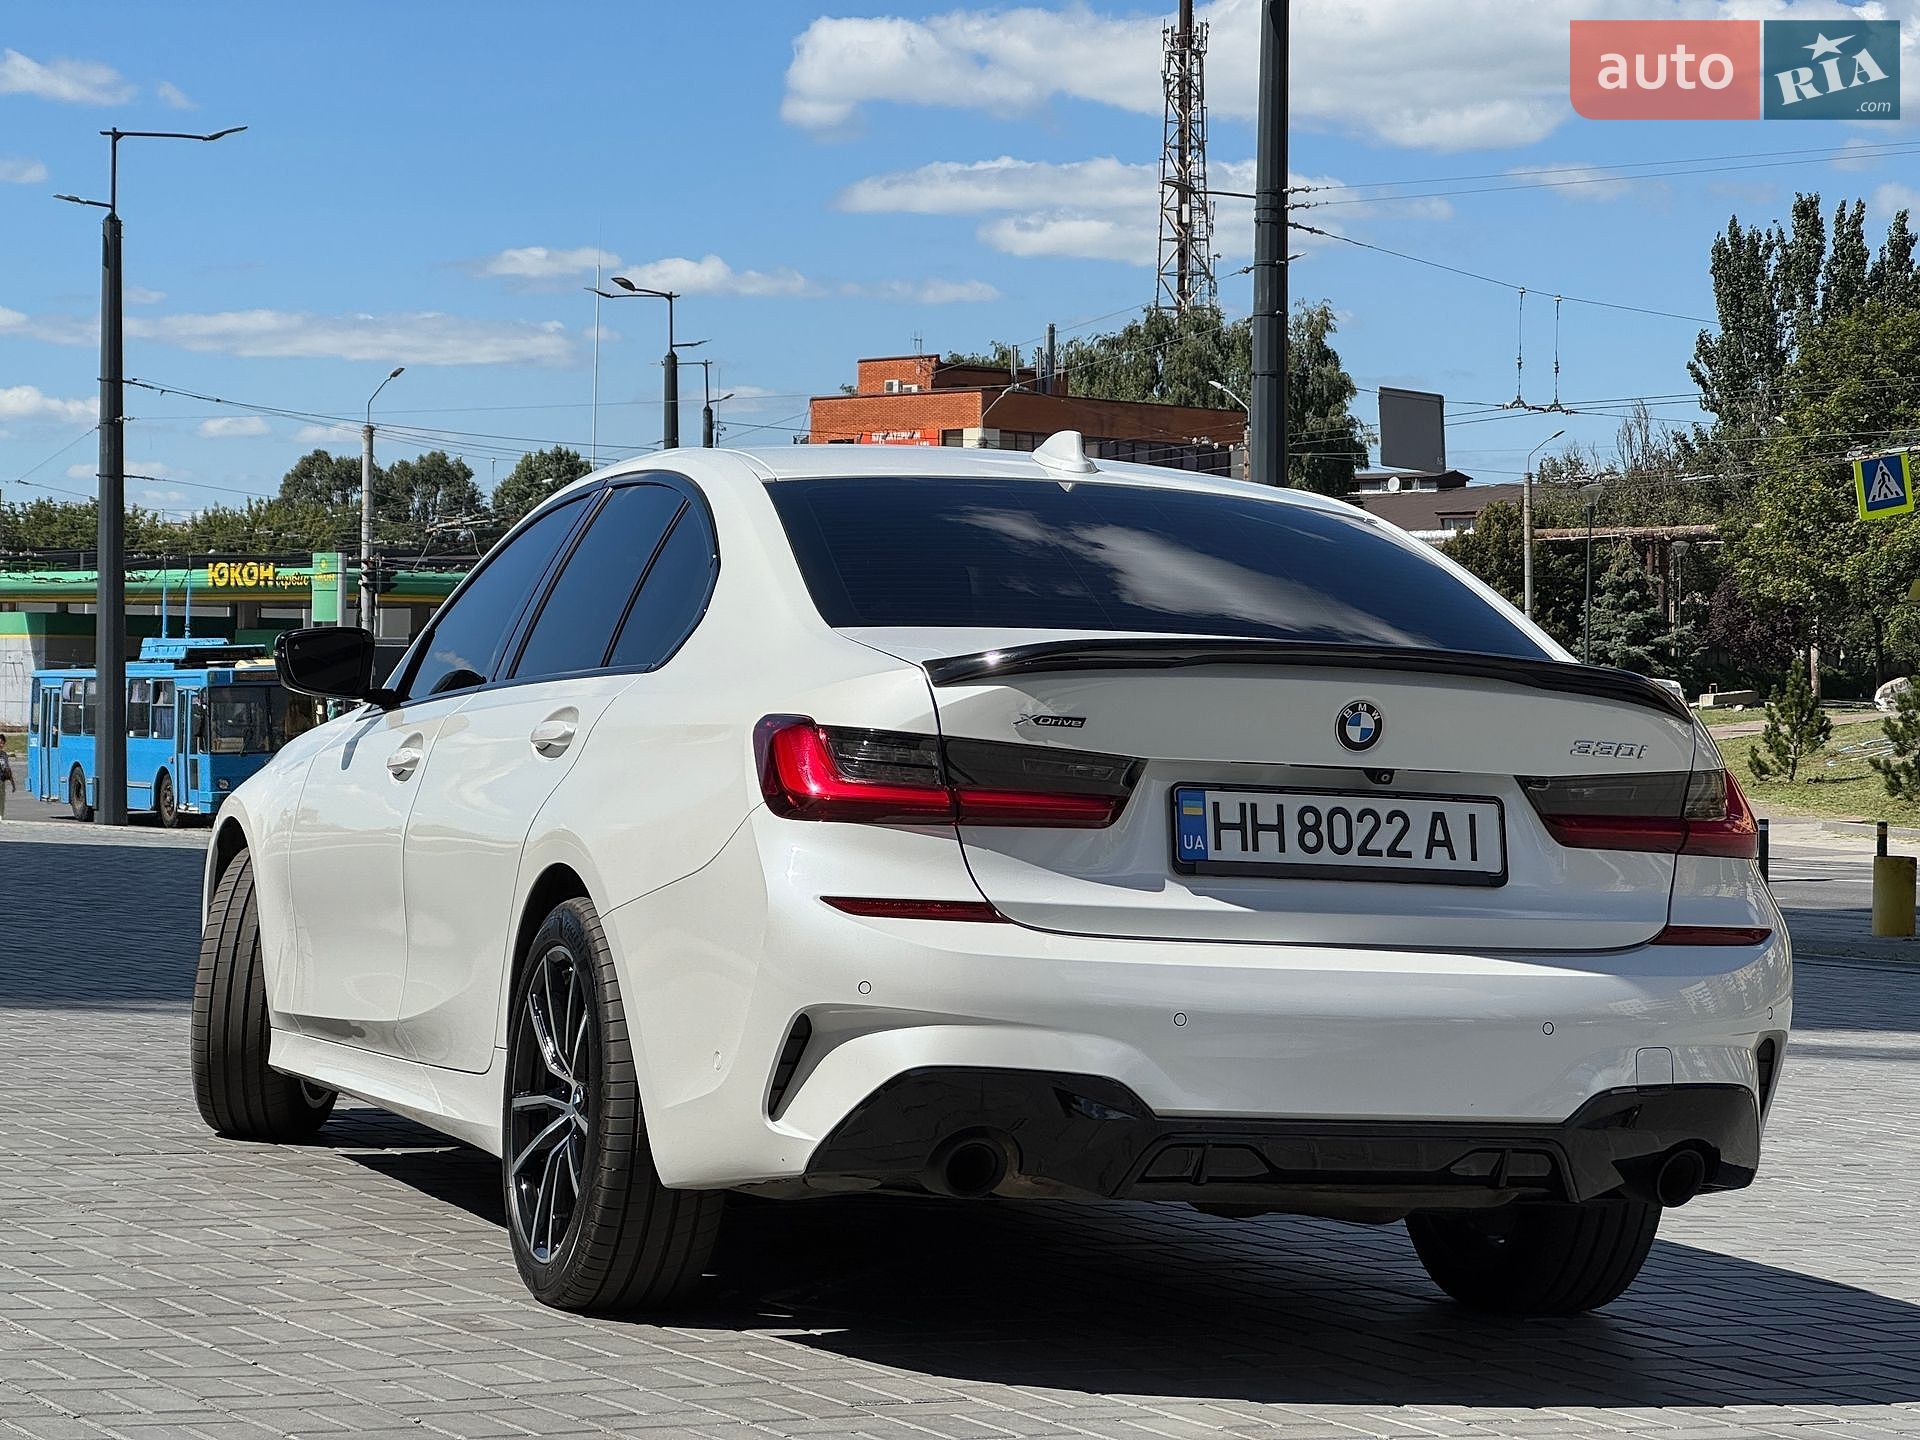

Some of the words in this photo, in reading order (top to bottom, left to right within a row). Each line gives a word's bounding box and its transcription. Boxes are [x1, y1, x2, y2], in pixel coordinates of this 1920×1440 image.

[207, 562, 275, 588] ЮКОН
[1343, 703, 1381, 721] BMW
[1569, 740, 1649, 760] 330i
[1212, 801, 1286, 854] HH
[1297, 805, 1413, 860] 8022
[1182, 834, 1206, 851] UA
